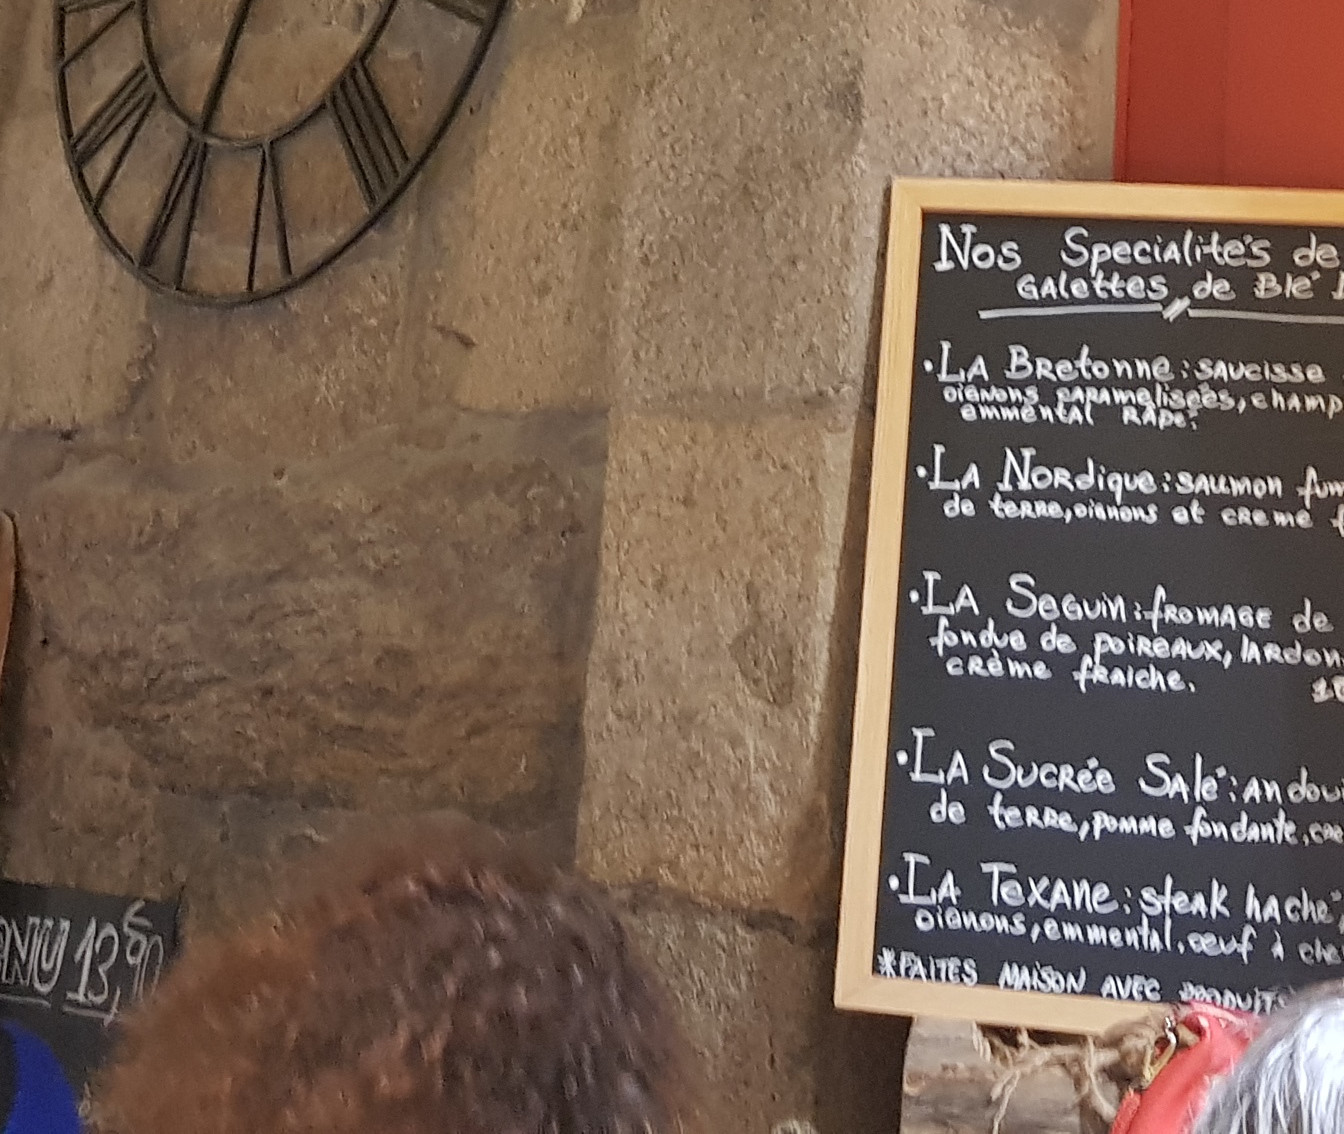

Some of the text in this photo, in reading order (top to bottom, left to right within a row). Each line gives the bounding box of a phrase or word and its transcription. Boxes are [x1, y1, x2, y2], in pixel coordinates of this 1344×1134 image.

[933, 223, 1022, 272] Nos
[1292, 231, 1341, 269] de
[1192, 269, 1236, 301] de
[942, 491, 976, 518] de
[1170, 498, 1206, 526] et
[1292, 597, 1334, 634] de
[1039, 622, 1078, 654] de
[929, 787, 966, 824] de
